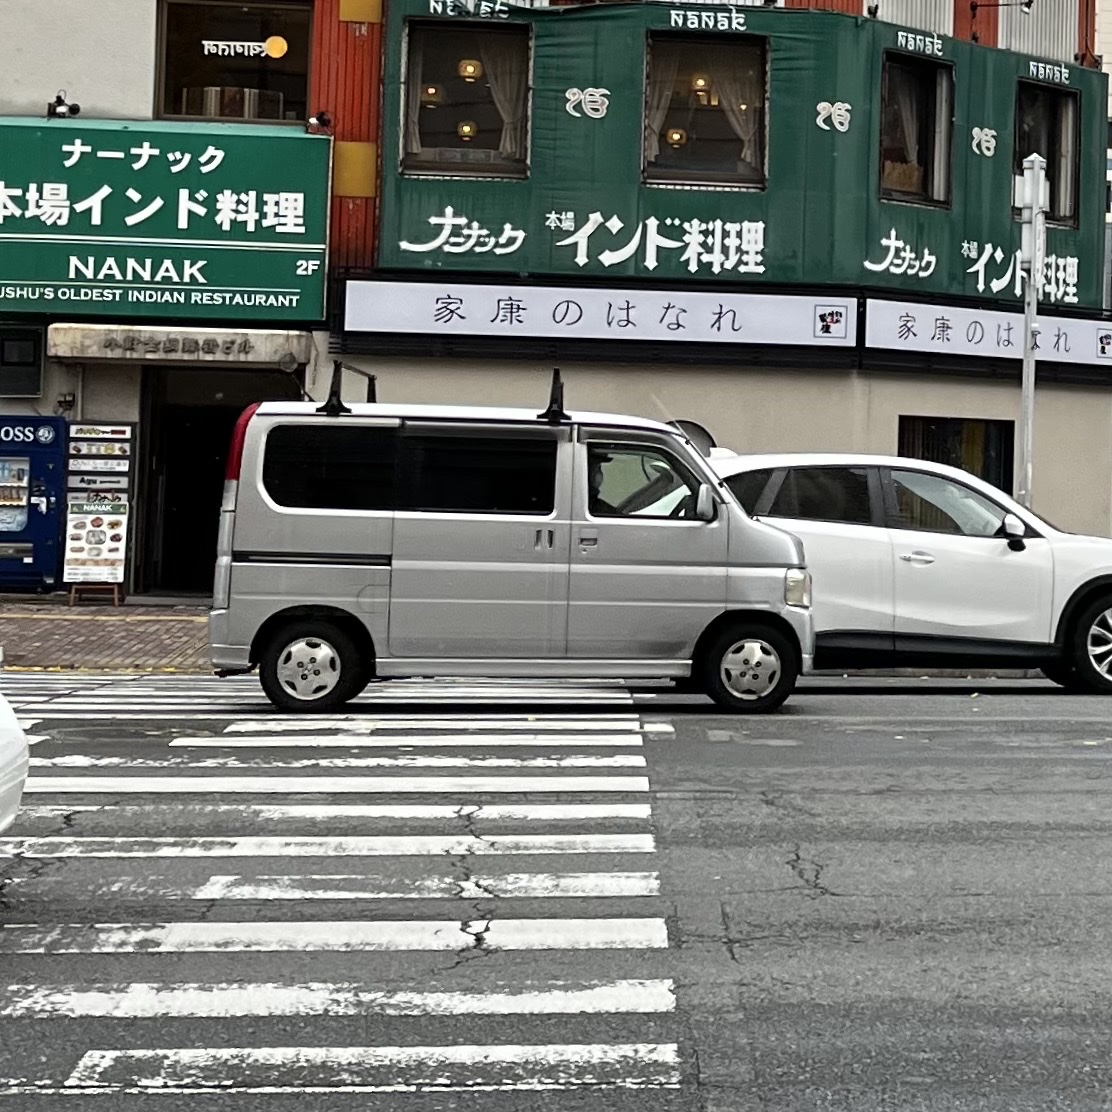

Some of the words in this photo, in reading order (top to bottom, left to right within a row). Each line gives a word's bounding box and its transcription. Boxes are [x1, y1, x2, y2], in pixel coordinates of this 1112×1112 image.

[62, 139, 225, 174] ナーナック
[0, 181, 306, 234] 本場インド料理
[68, 255, 208, 284] NANAK
[296, 260, 321, 275] 2F
[57, 288, 123, 301] OLDEST
[128, 290, 185, 304] INDIAN
[190, 292, 300, 307] RESTAURANT
[434, 294, 742, 333] 家康のはなれ
